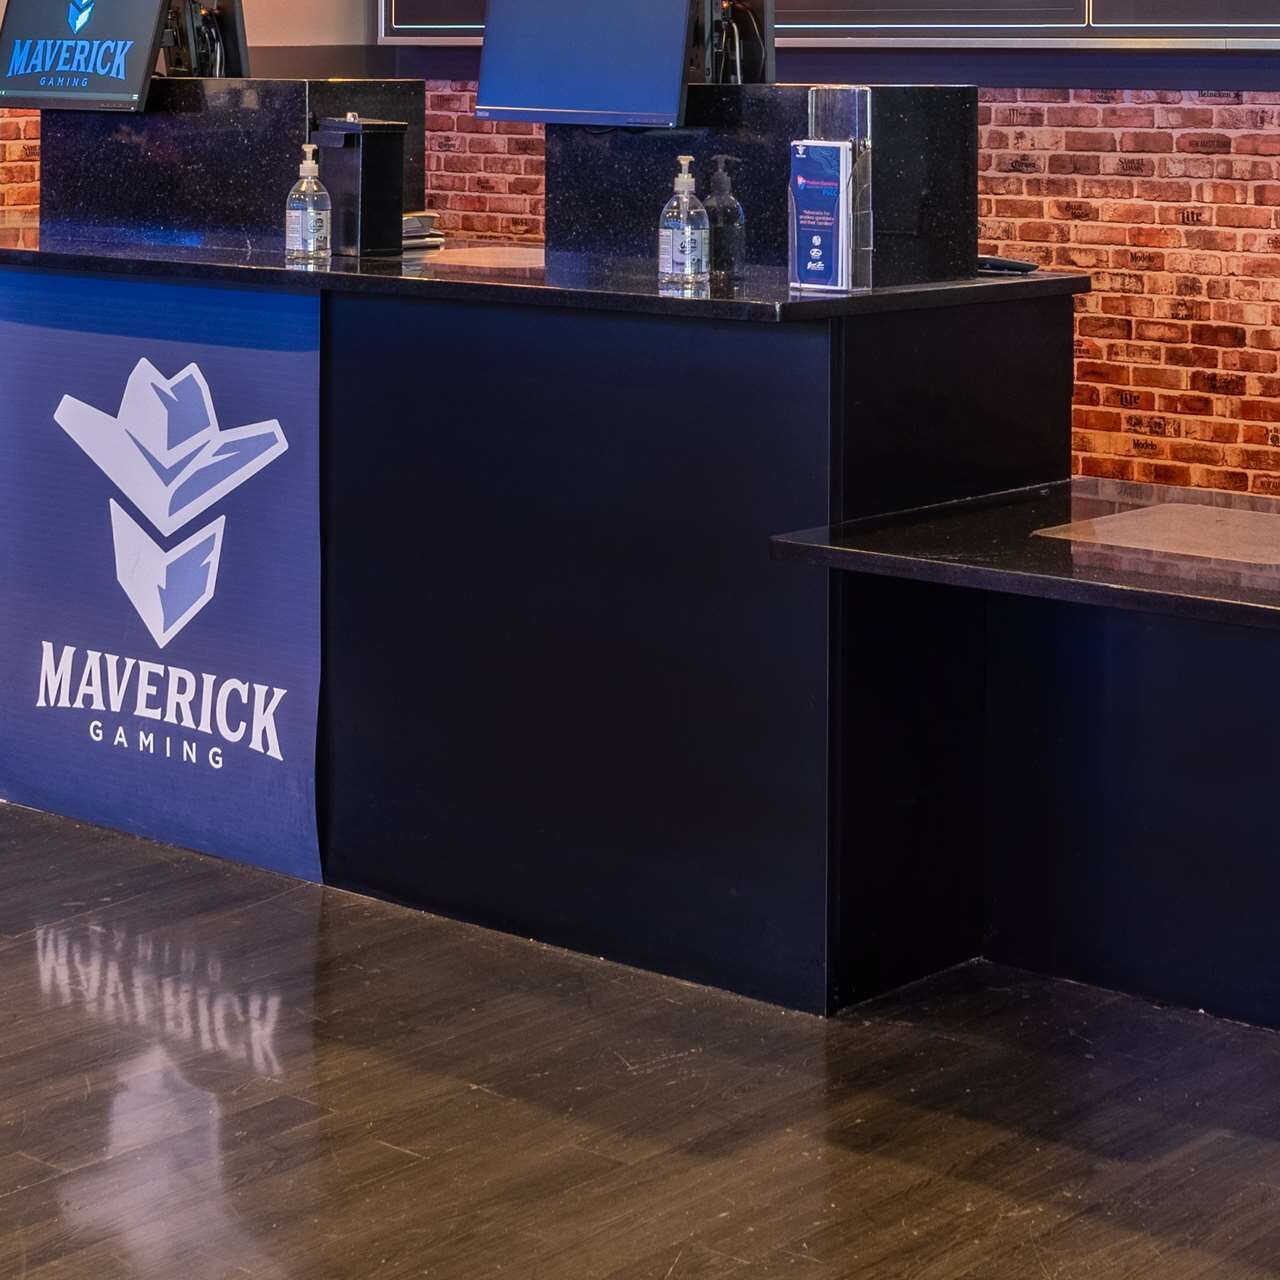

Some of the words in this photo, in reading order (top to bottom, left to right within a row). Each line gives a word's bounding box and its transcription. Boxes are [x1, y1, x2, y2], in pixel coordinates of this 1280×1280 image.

[6, 40, 134, 80] MAVERICK
[40, 77, 88, 87] GAMING
[1179, 210, 1202, 225] Lite
[36, 640, 288, 761] MAVERICK
[90, 720, 223, 769] GAMING
